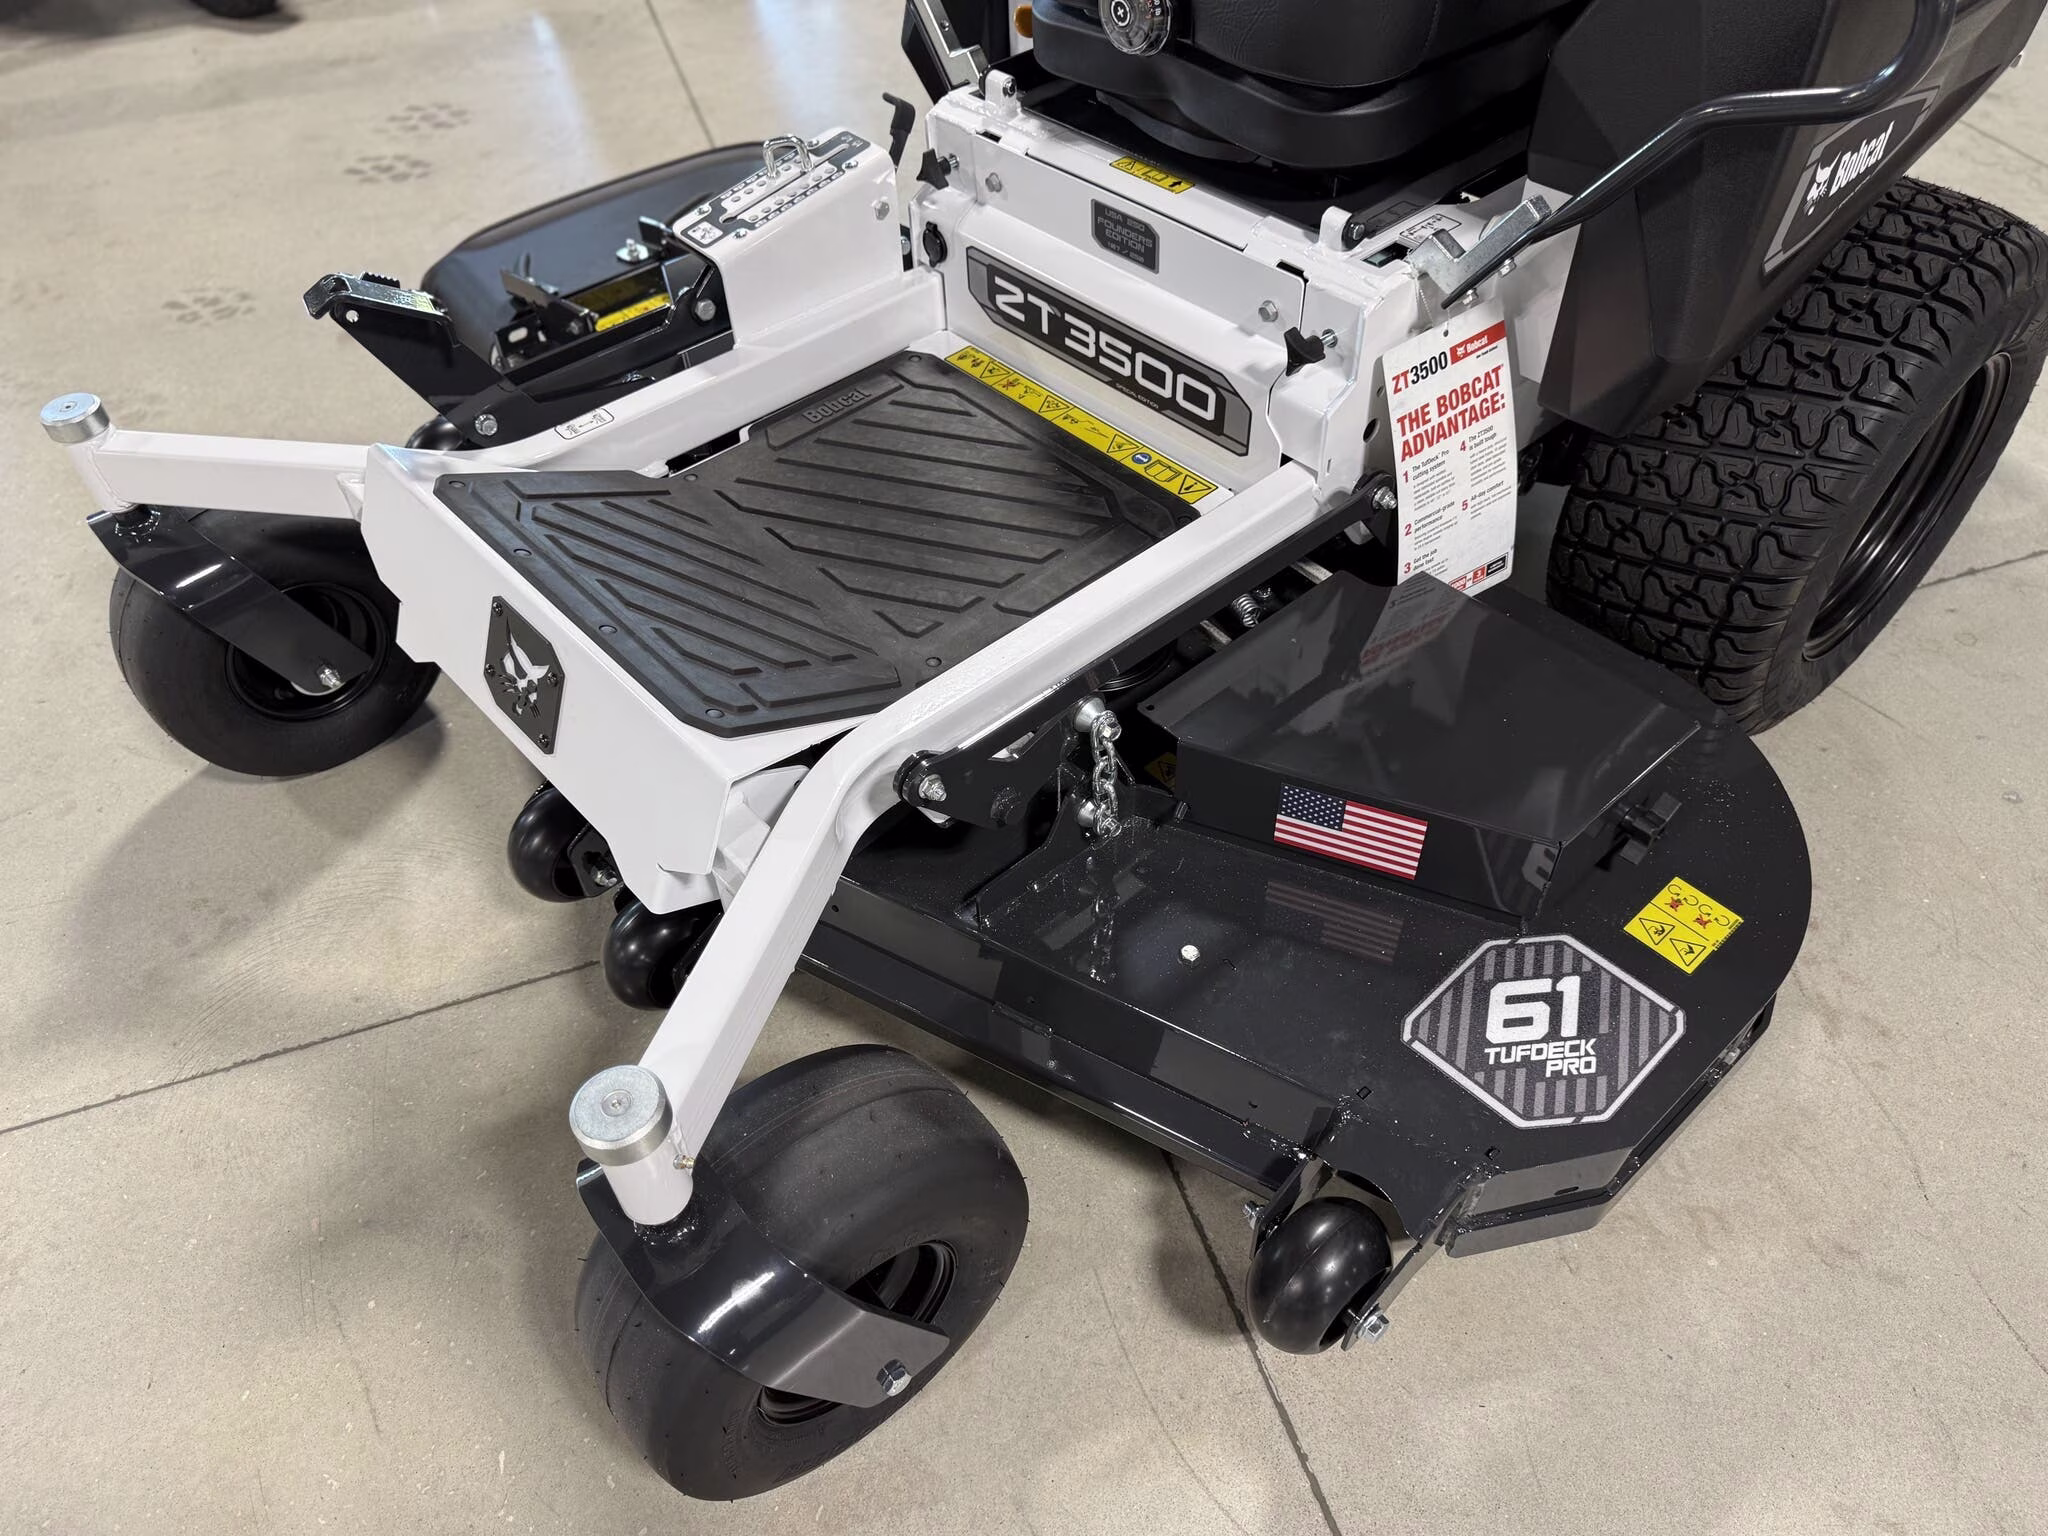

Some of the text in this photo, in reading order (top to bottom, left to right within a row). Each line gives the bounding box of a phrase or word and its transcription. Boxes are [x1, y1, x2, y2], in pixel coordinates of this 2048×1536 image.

[1828, 120, 1895, 197] Bobcat
[1104, 208, 1123, 222] USA
[1097, 216, 1153, 248] FOUNDERS
[1105, 229, 1145, 253] EDITION
[994, 275, 1217, 421] ZT3500
[1466, 335, 1489, 353] Bobcat
[1391, 351, 1448, 395] ZT3500
[801, 388, 873, 423] Bobcat
[1397, 365, 1502, 437] THE BOBCAT
[1400, 391, 1506, 462] ADVANTAGE:
[1459, 440, 1467, 452] 4
[1403, 470, 1409, 483] 1
[1461, 499, 1469, 511] 5
[1404, 523, 1413, 537] 2
[1403, 561, 1412, 575] 3
[1485, 975, 1581, 1045] 61
[1484, 1038, 1597, 1065] TUFDECK
[1545, 1056, 1597, 1078] PRO
